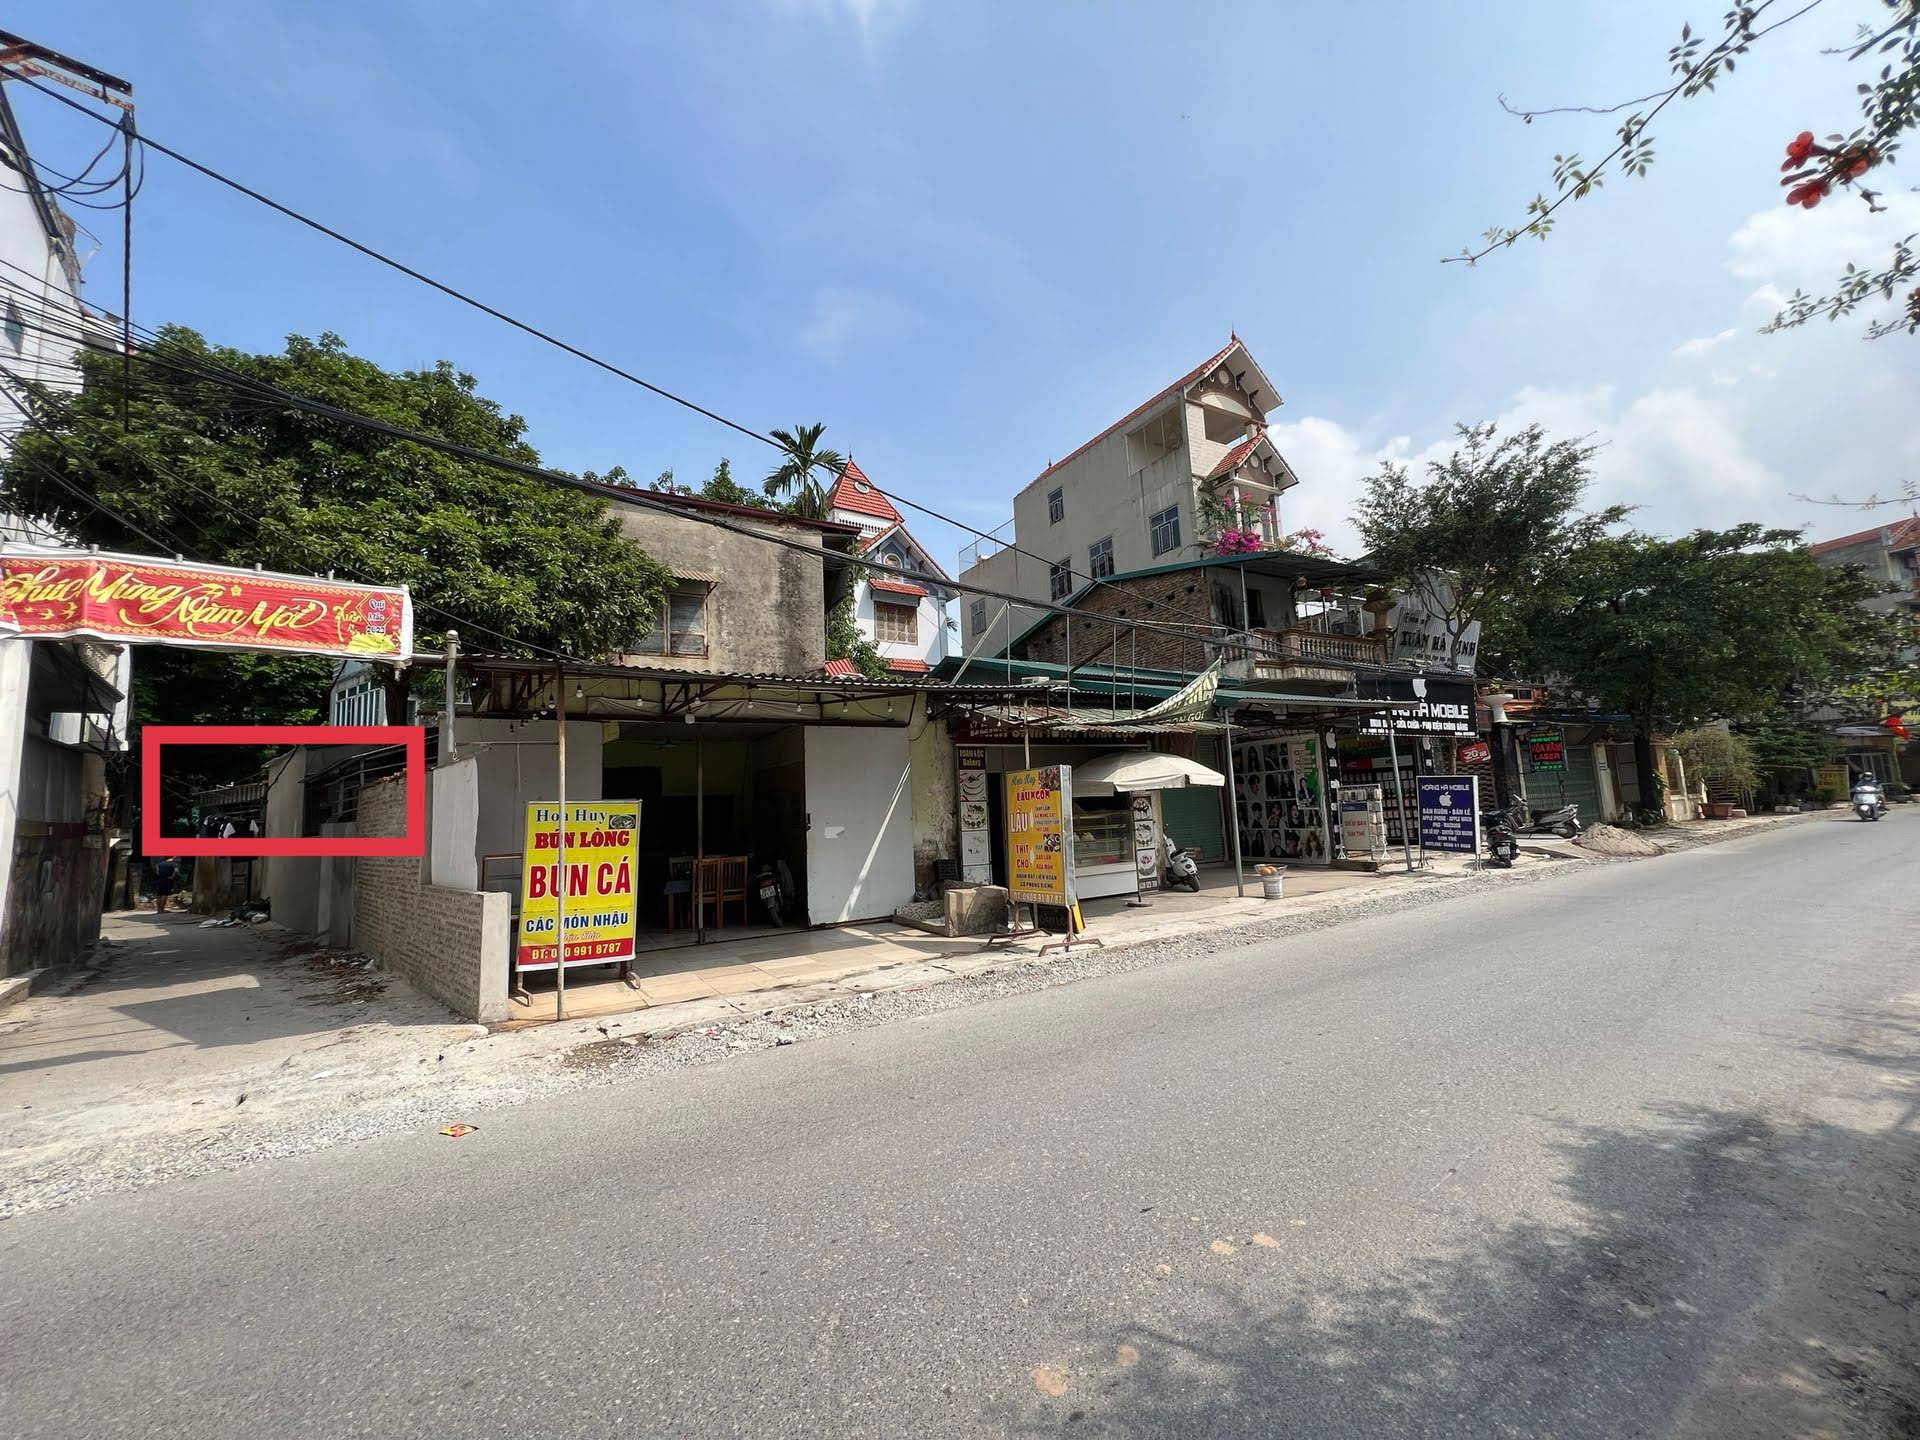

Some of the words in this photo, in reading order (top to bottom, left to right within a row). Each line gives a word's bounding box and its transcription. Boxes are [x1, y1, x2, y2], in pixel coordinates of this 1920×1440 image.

[80, 566, 184, 613] Mừng
[250, 598, 328, 636] Mới
[1431, 703, 1469, 719] MOBILE
[576, 809, 607, 824] Huy
[535, 828, 575, 849] BÚN
[580, 826, 630, 848] LÒNG
[529, 861, 588, 898] BÚN
[597, 856, 631, 895] CÁ
[526, 916, 554, 932] CÁC
[563, 914, 589, 929] MÓN
[593, 911, 628, 928] NHẬU
[532, 949, 548, 960] ĐT:
[551, 947, 571, 958] 00
[573, 945, 592, 957] 991
[596, 942, 621, 955] 8787
